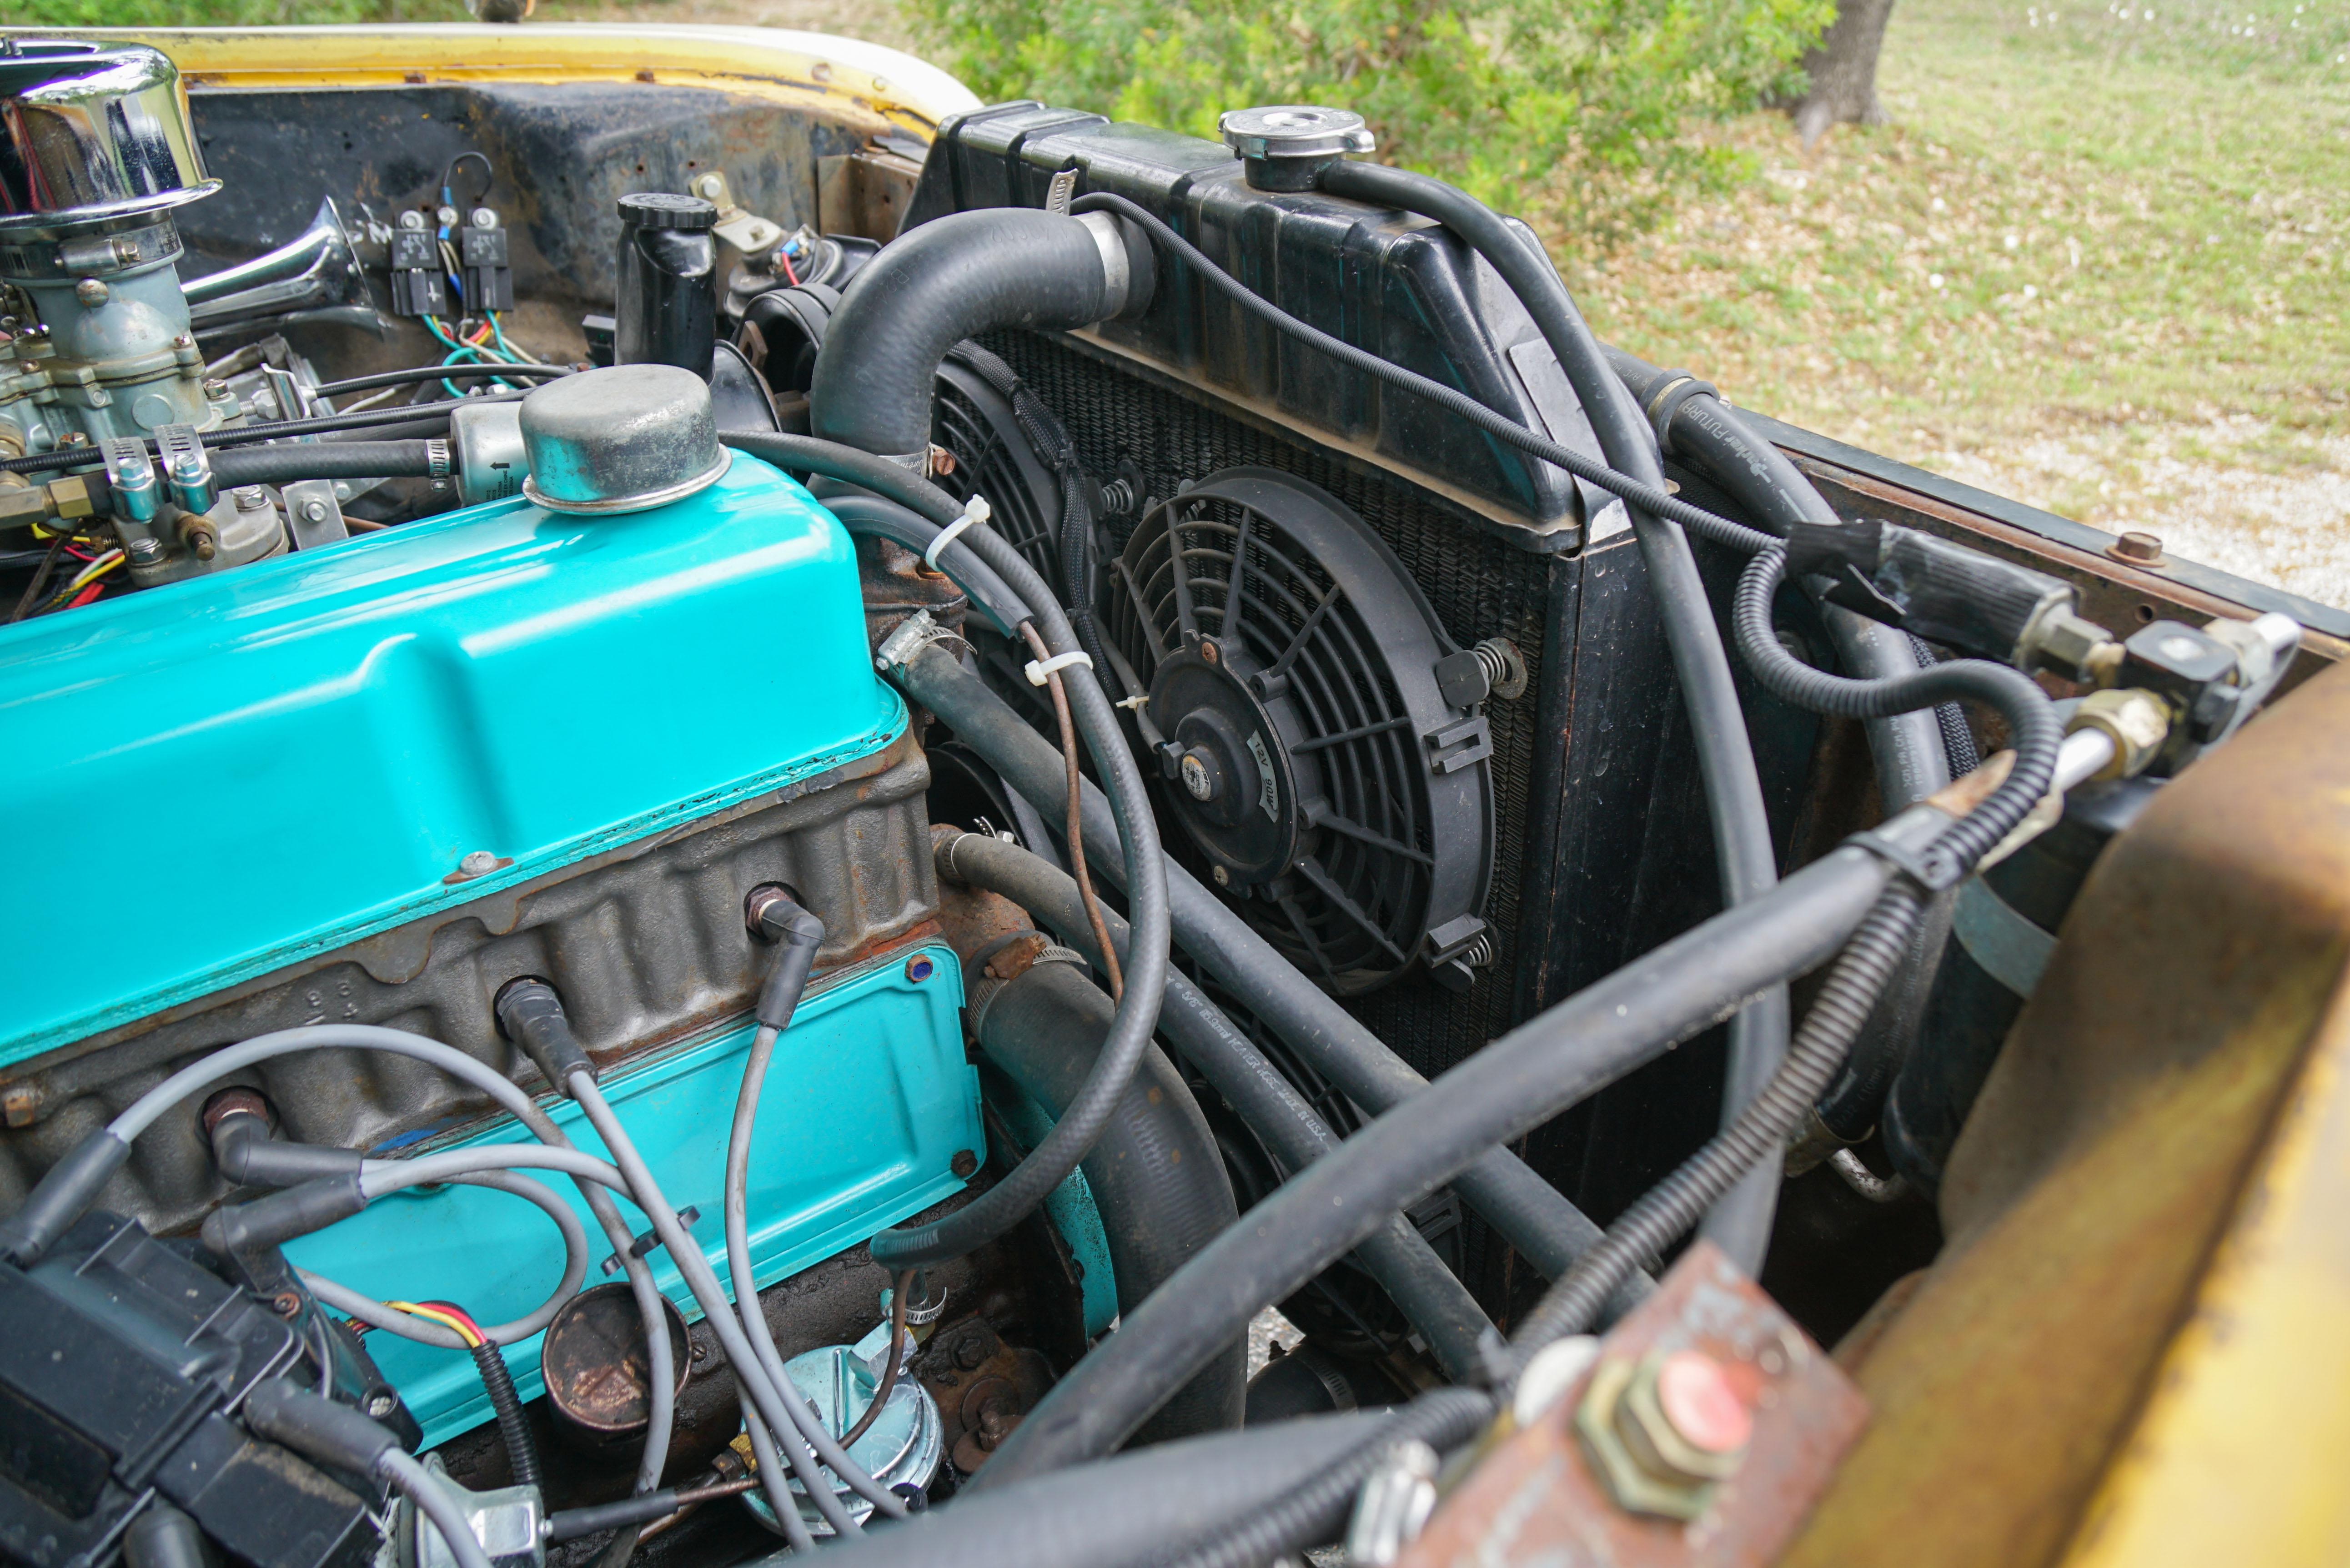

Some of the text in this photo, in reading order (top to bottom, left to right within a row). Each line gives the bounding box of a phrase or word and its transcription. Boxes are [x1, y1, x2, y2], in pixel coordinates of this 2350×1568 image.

[1684, 402, 1772, 483] Parker FUTURA
[1255, 741, 1274, 804] 12V 90W
[1228, 1037, 1260, 1069] HEATER
[1256, 1069, 1281, 1090] HOSE
[1297, 1111, 1310, 1121] IN
